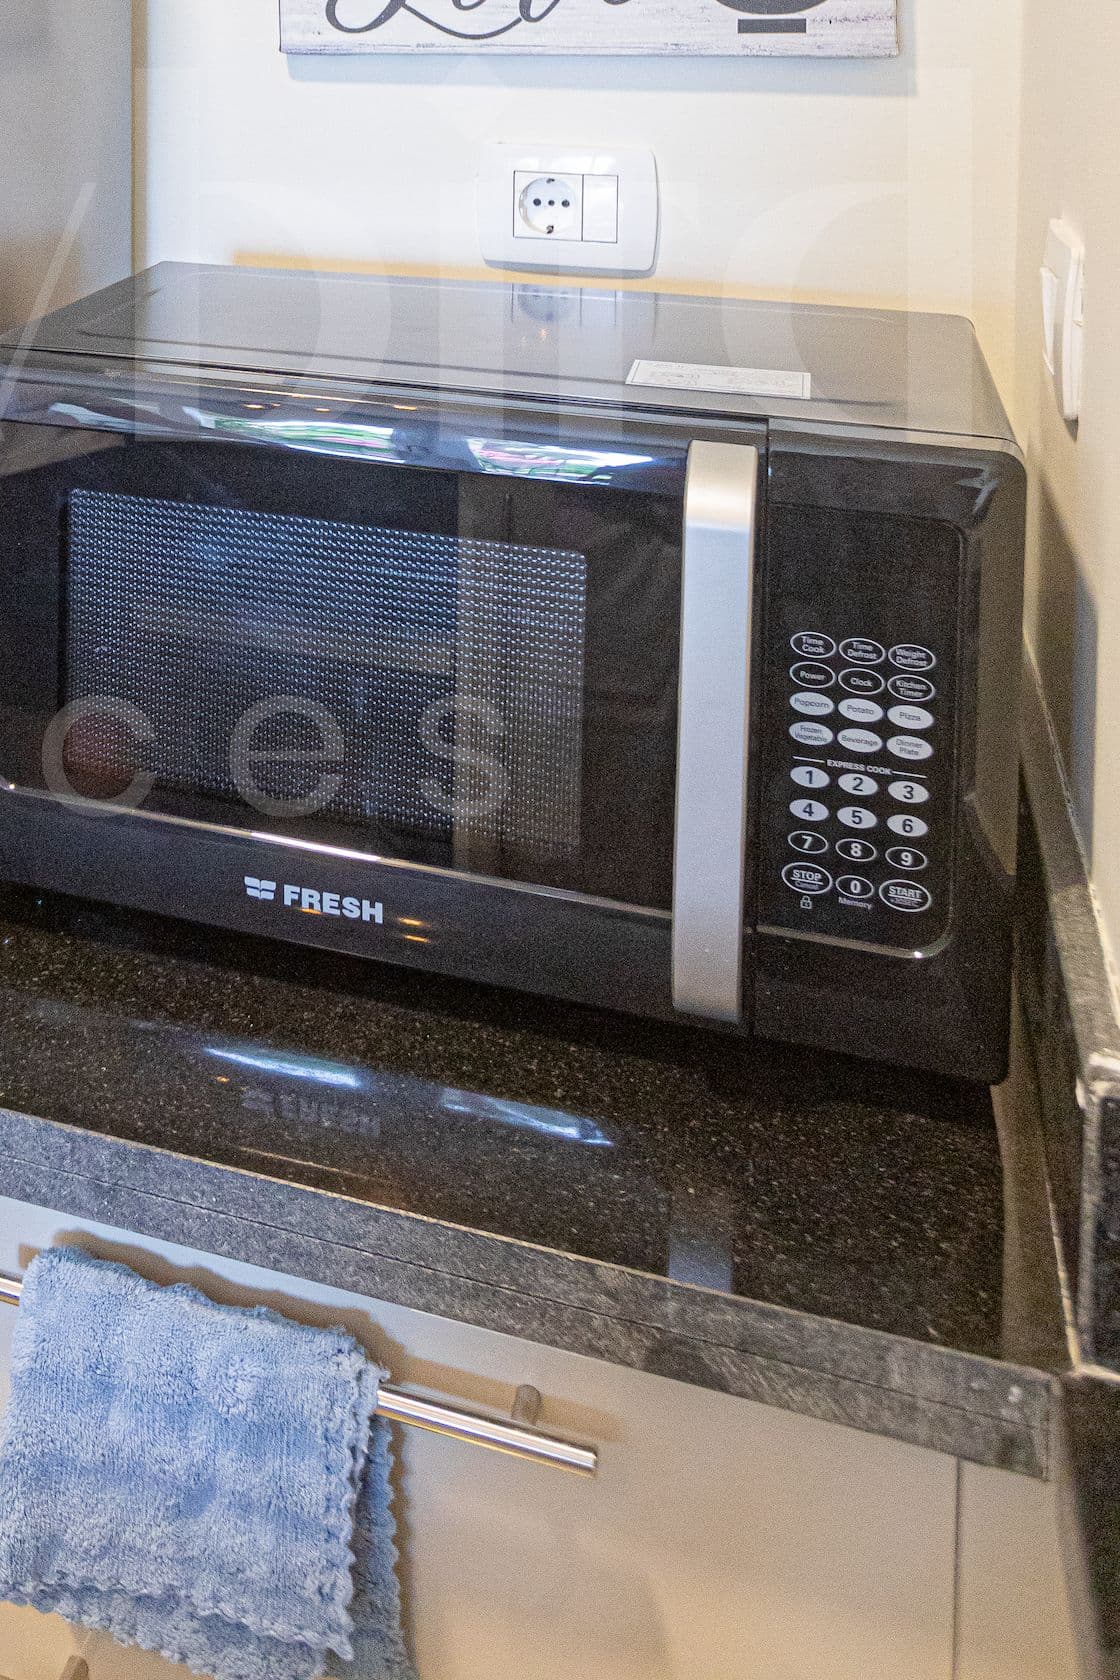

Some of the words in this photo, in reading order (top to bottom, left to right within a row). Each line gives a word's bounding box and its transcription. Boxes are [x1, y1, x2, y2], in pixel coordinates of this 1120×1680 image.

[800, 635, 824, 646] Time
[852, 641, 874, 652] Time
[801, 644, 825, 655] Cook
[846, 648, 878, 661] Defrost
[895, 655, 929, 668] Defrost
[799, 670, 826, 681] Power
[850, 677, 873, 688] Clock
[895, 679, 928, 691] Kitchen
[899, 687, 924, 699] Timer
[794, 696, 830, 709] Popcorn
[846, 703, 875, 715] Potato
[899, 710, 922, 722] Pizza
[841, 734, 878, 747] Beverage
[826, 759, 866, 772] EXPRESS
[866, 764, 892, 776] COOK
[805, 770, 814, 785] 1
[852, 776, 864, 792] 2
[902, 784, 914, 800] 3
[802, 802, 814, 817] 4
[851, 809, 863, 825] 5
[901, 818, 913, 834] 6
[801, 835, 813, 849] 7
[849, 842, 862, 858] 8
[899, 851, 913, 866] 9
[792, 869, 822, 882] STOP
[849, 880, 861, 894] 0
[888, 885, 922, 899] START
[282, 883, 384, 925] FRESH
[838, 897, 873, 910] Memory
